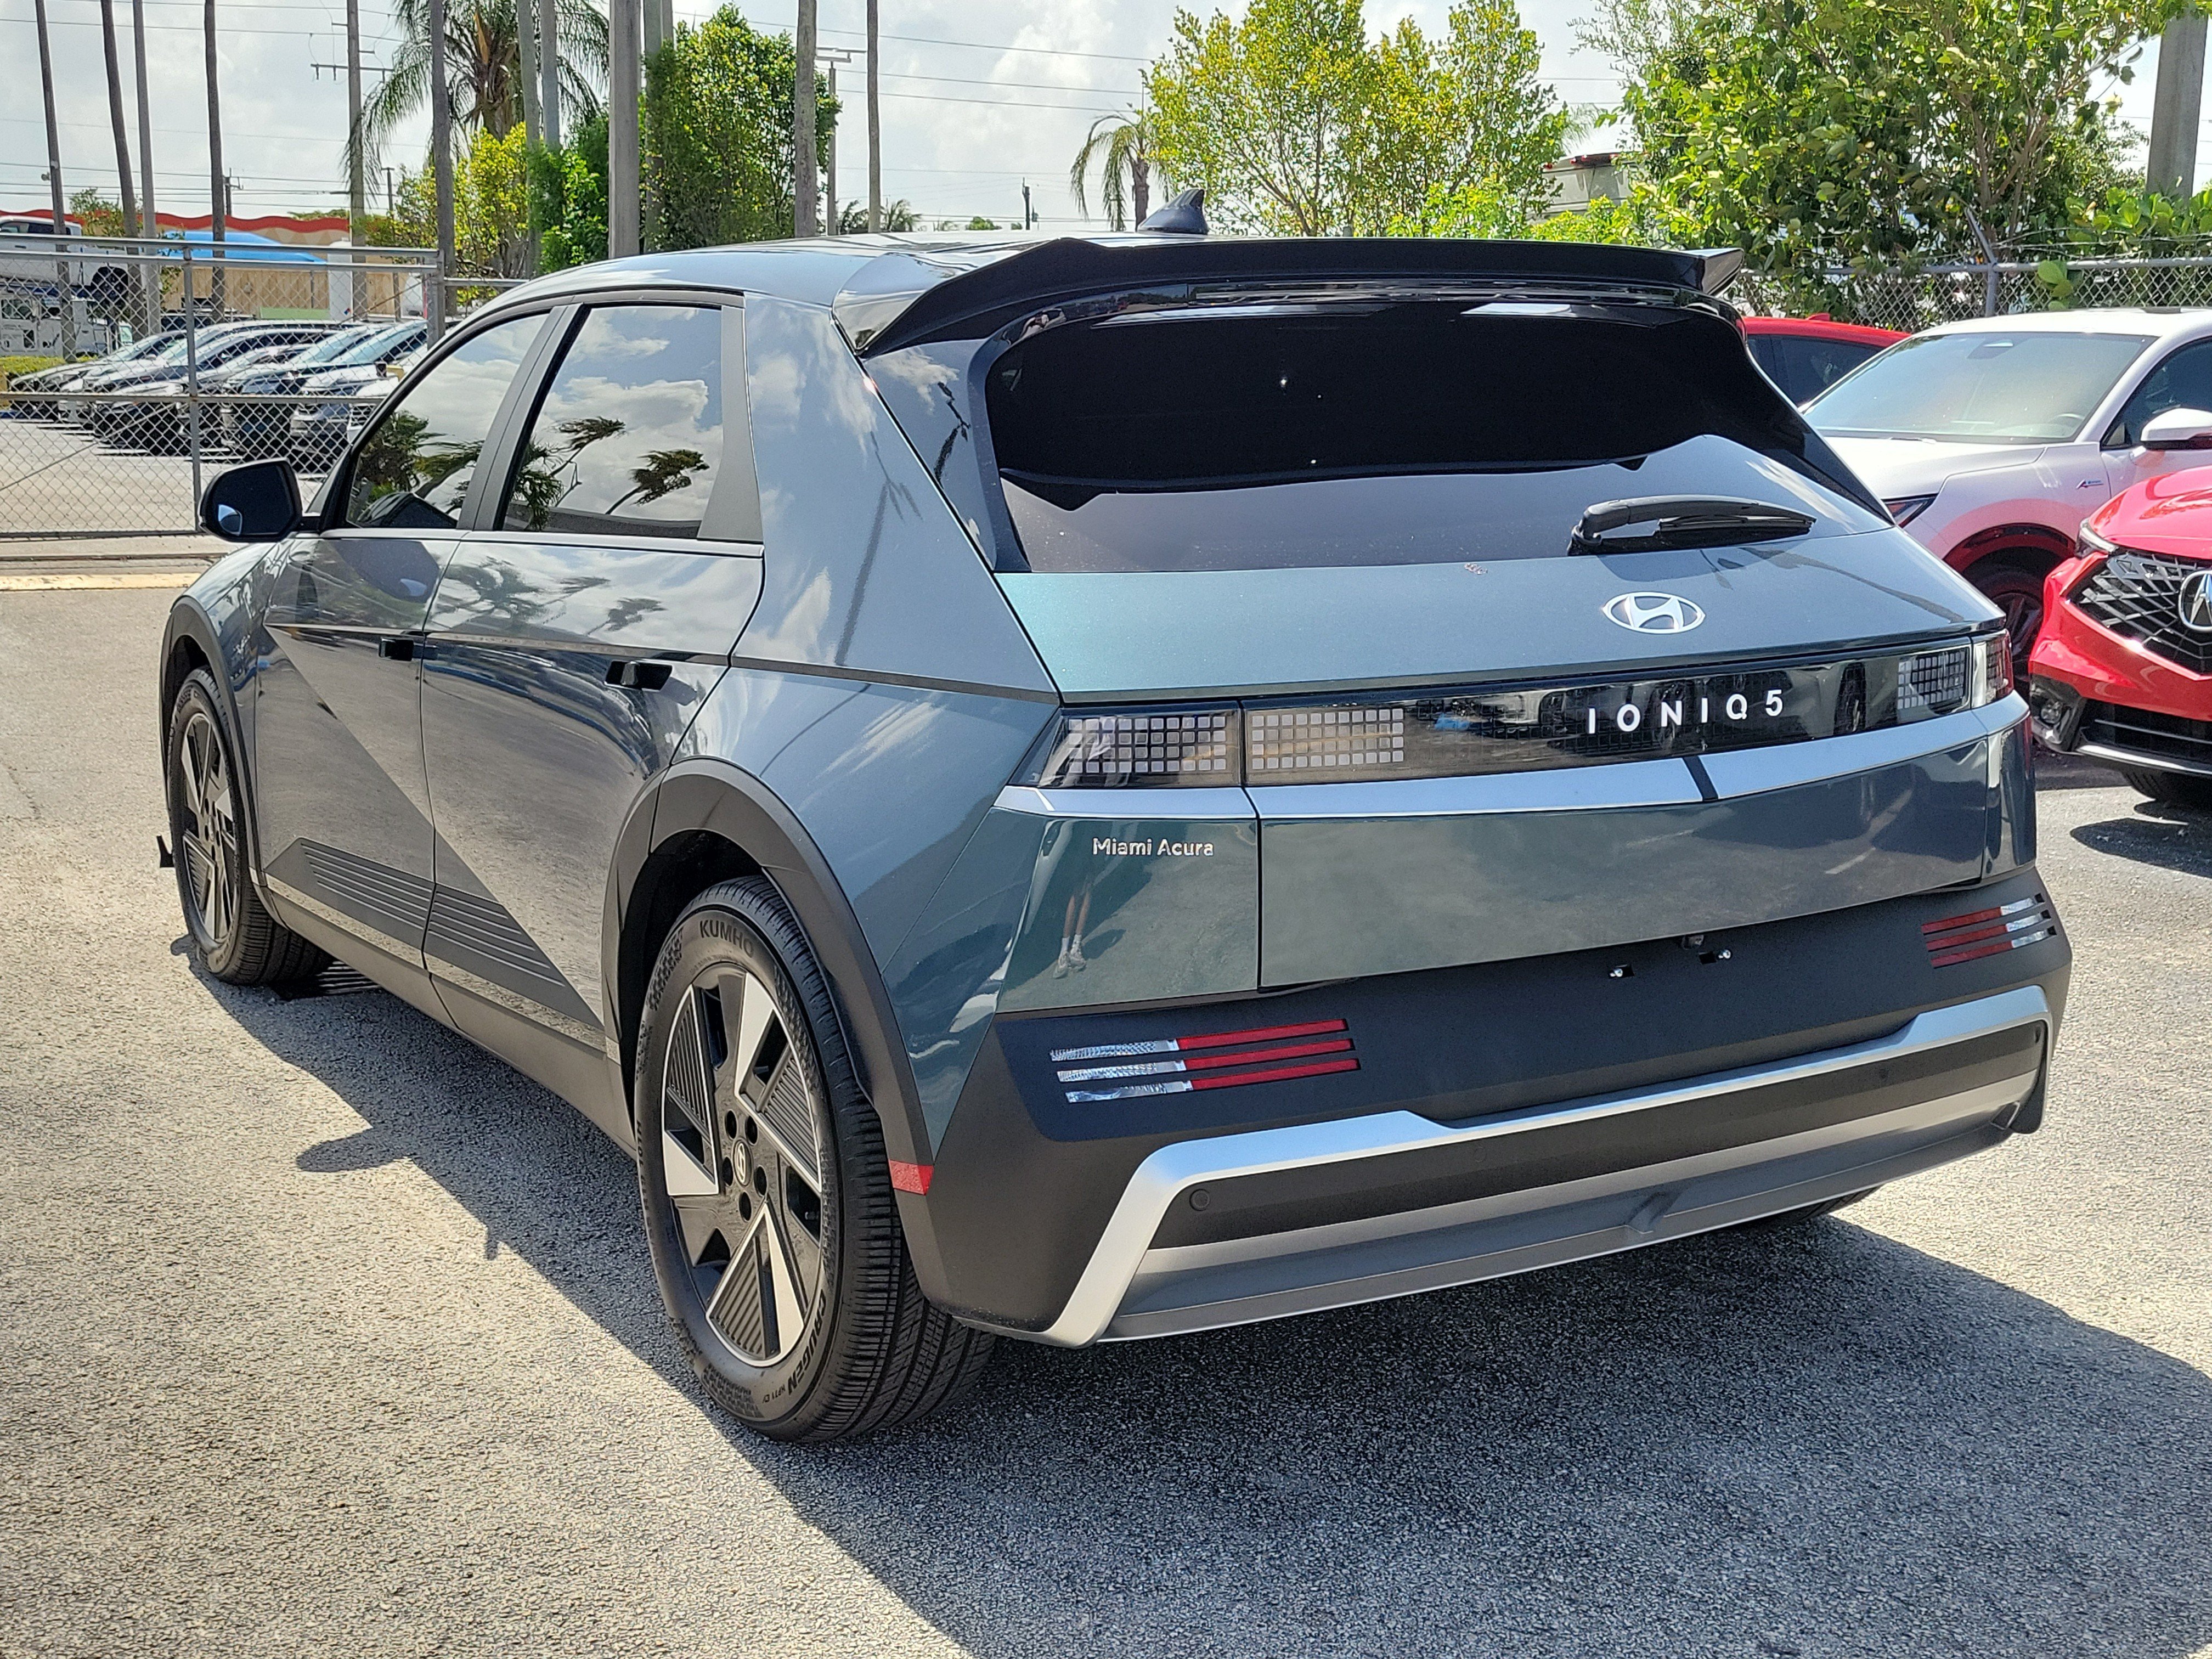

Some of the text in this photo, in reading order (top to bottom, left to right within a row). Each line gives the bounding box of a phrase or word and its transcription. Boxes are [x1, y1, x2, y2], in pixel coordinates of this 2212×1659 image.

[1588, 689, 1784, 734] IONIQ 5
[1093, 837, 1214, 856] Miami Acura
[699, 919, 754, 958] KUMHO
[787, 1288, 827, 1396] CRUGEN
